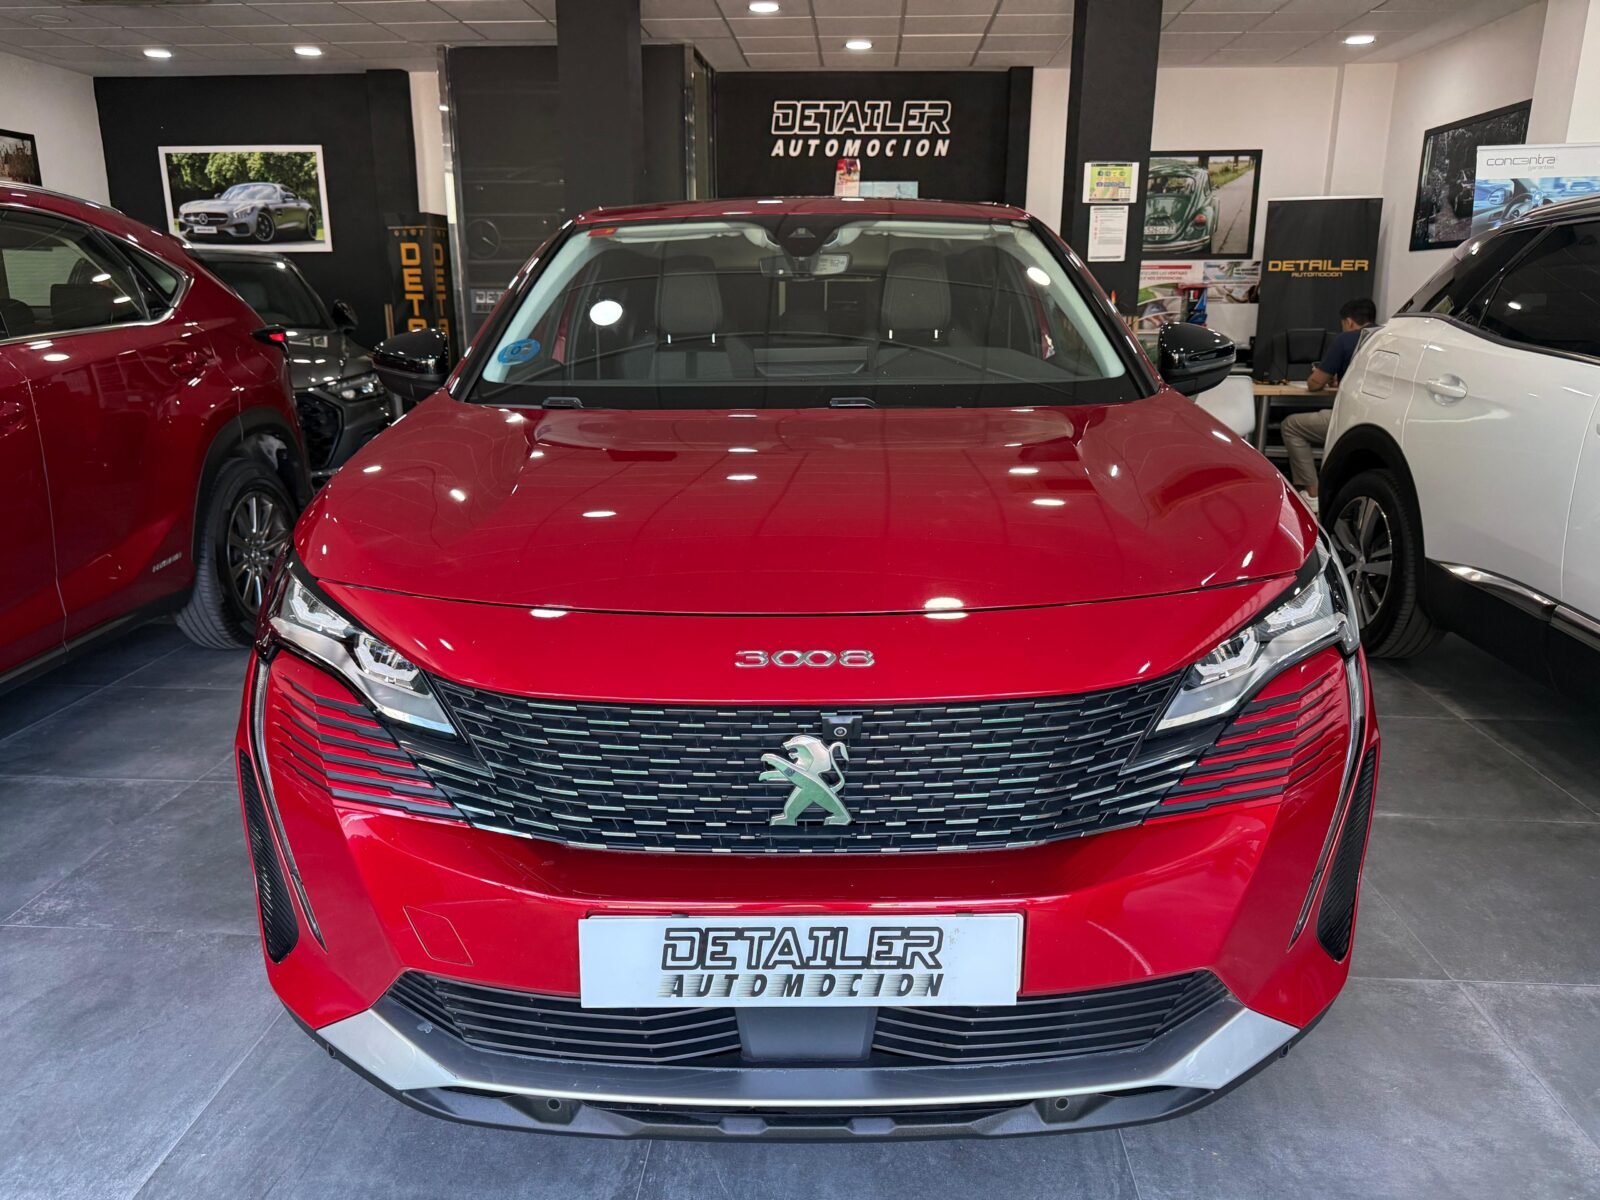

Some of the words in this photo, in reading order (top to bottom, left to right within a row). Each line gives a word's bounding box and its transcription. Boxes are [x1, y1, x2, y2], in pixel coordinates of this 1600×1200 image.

[771, 101, 951, 134] DETAILER
[770, 139, 950, 157] AUTOMOCION
[1268, 260, 1369, 272] DETAILER
[735, 650, 875, 667] 3008
[661, 927, 944, 970] DETAILER
[660, 973, 944, 998] AUTOMOCION
